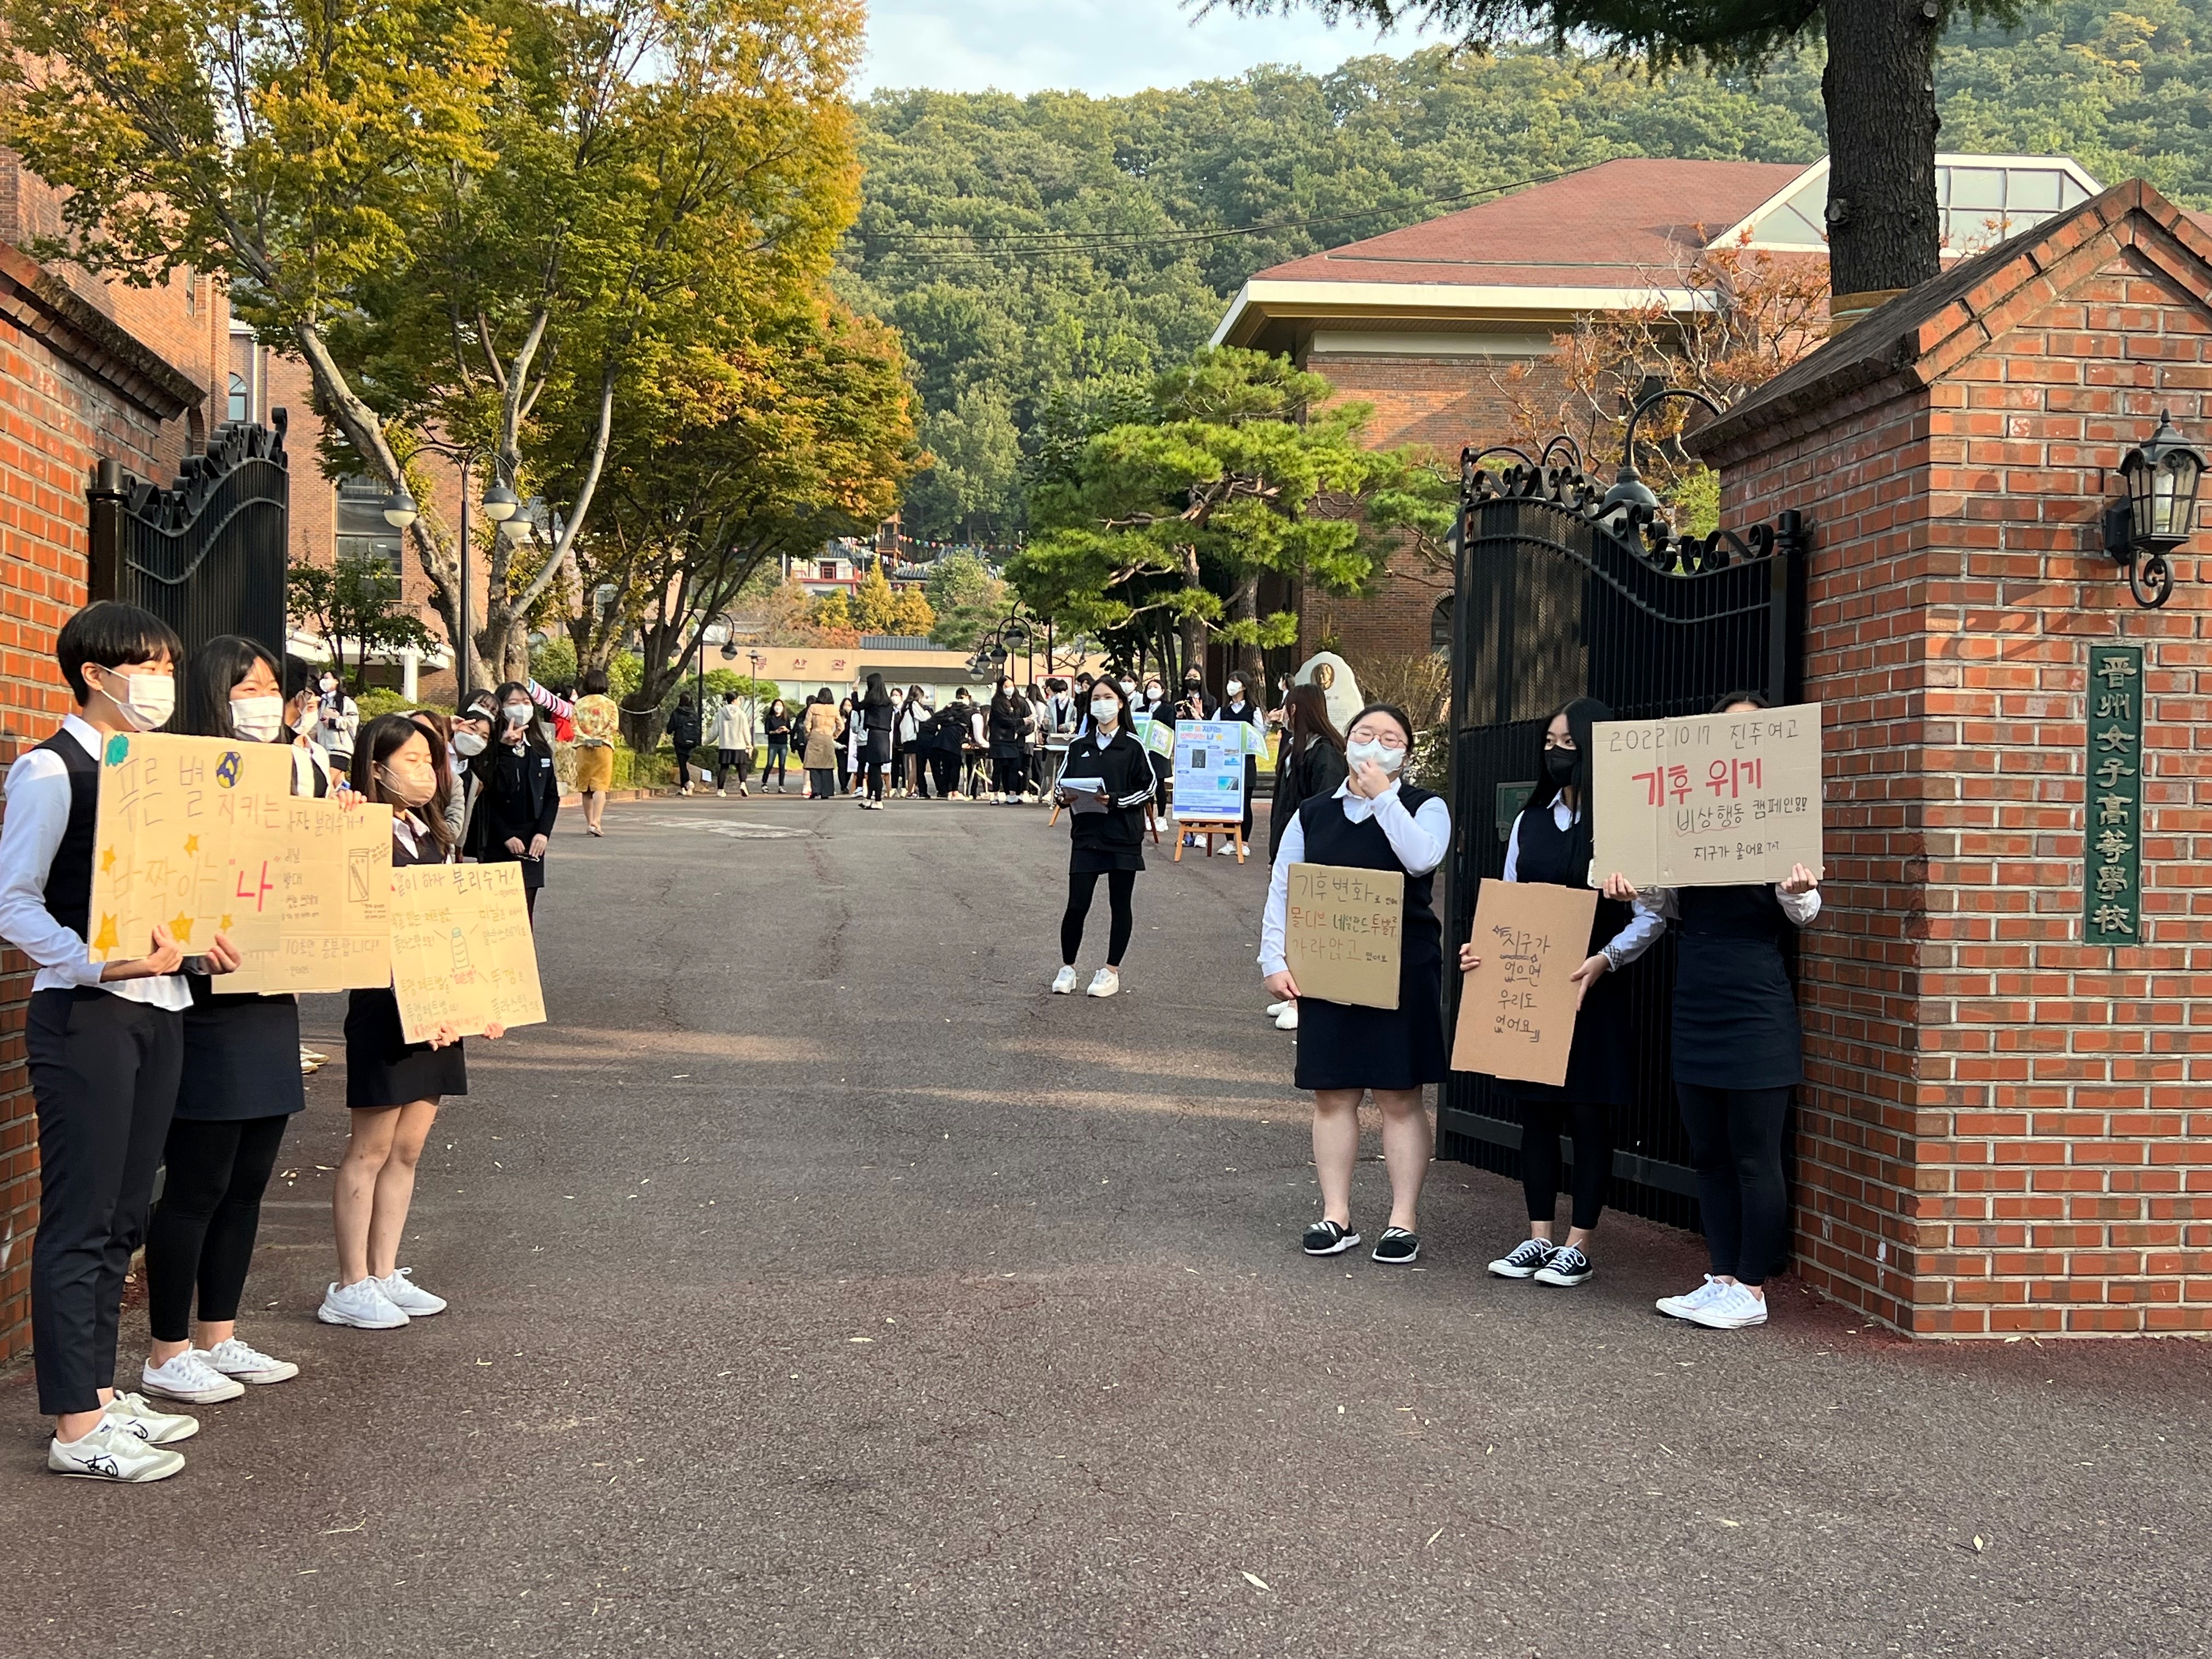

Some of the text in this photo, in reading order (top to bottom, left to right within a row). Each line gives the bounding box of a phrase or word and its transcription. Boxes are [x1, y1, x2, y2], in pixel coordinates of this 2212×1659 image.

[1730, 719, 1799, 750] 진주여고
[115, 755, 281, 833] 푸른 별 지키는
[1631, 757, 1762, 808] 기후 위기
[1675, 802, 1745, 834] 비상행동
[1692, 845, 1730, 861] 지구가
[1735, 842, 1764, 861] 울어요
[112, 851, 219, 927] 반짝이는
[393, 871, 418, 898] 같이
[422, 871, 445, 889] 하자
[452, 866, 517, 895] 분리수거!
[1290, 906, 1328, 930] 몰디브
[1370, 913, 1398, 938] 투발루
[1291, 936, 1363, 962] 가라앉고
[1504, 961, 1542, 988] 없으면
[1497, 989, 1538, 1011] 우리도
